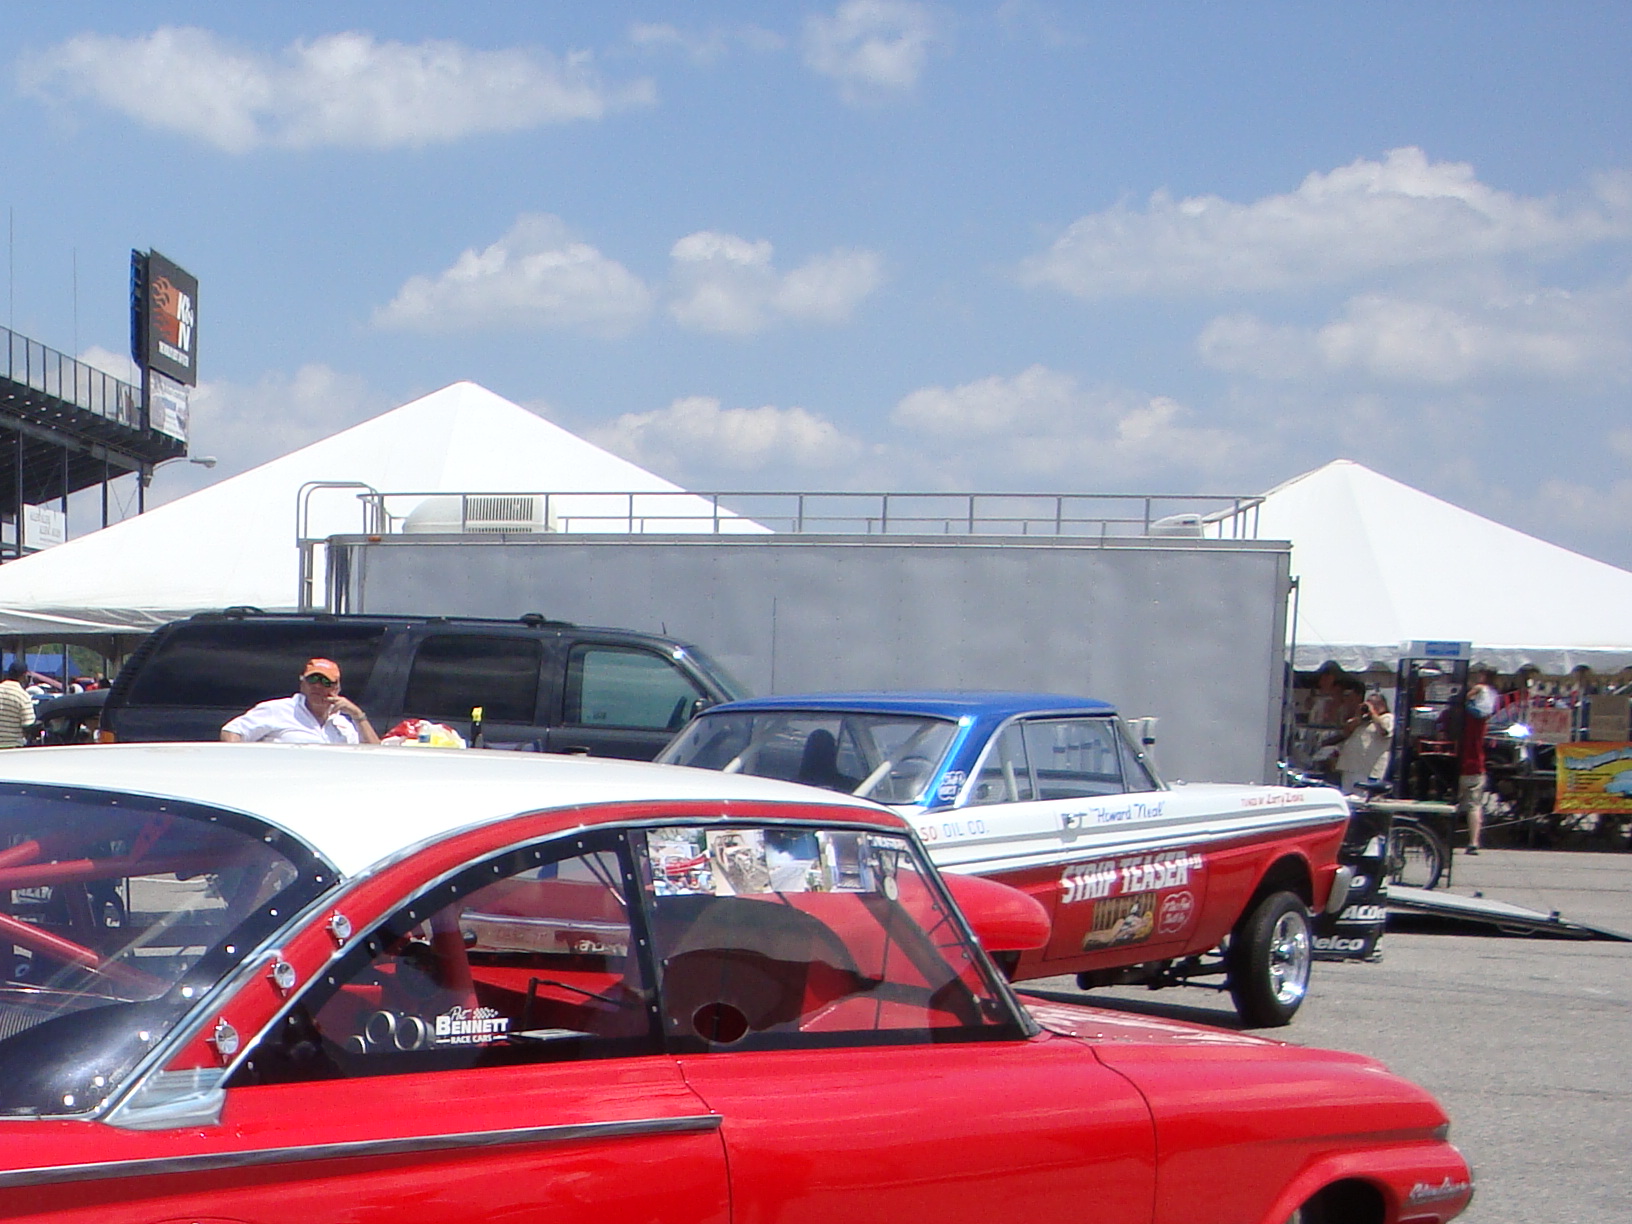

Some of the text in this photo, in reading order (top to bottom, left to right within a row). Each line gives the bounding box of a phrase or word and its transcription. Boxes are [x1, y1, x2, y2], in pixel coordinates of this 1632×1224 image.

[943, 823, 965, 838] OIL
[1061, 861, 1117, 904] STRIP
[1312, 934, 1365, 951] elco
[436, 1016, 509, 1036] BENNETT
[450, 1034, 493, 1045] RACE CARS
